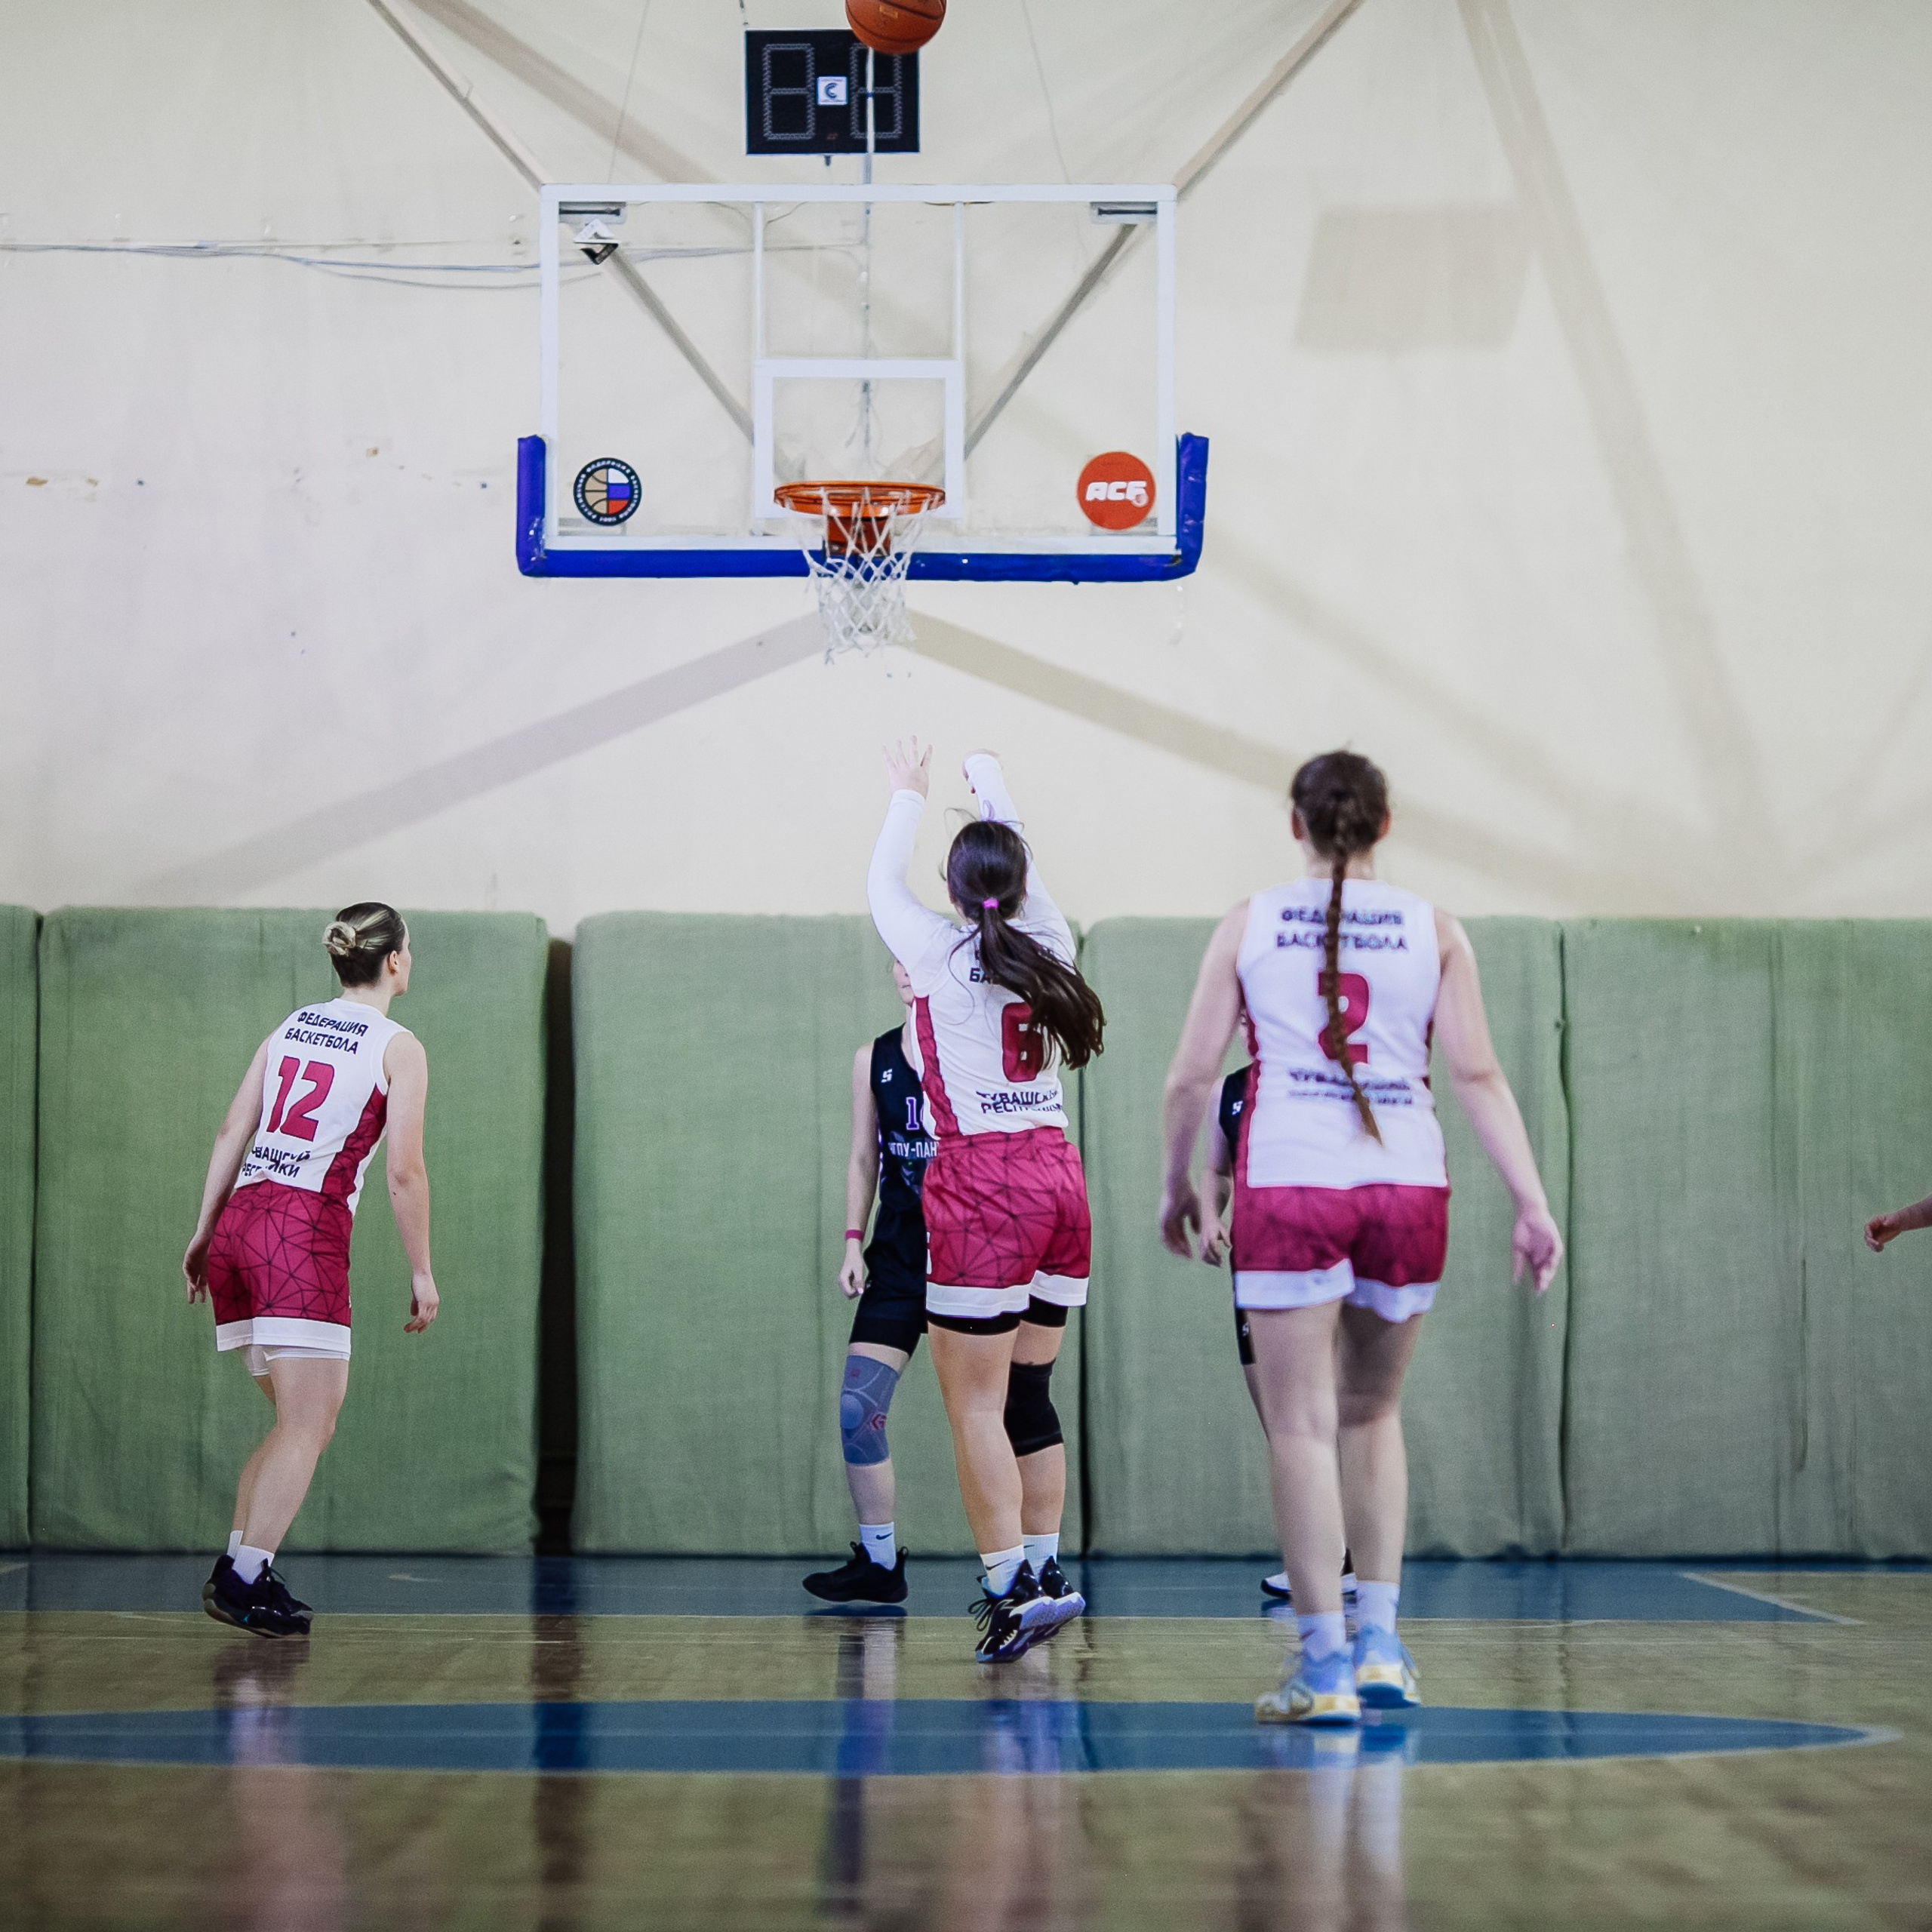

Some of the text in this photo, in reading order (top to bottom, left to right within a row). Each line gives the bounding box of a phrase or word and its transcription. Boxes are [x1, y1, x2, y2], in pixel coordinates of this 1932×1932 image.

[285, 1027, 359, 1054] БАСКЕТБОЛА
[297, 1011, 369, 1038] ФЕДЕРАЦИЯ
[1001, 1001, 1044, 1083] 6
[1318, 971, 1369, 1065] 2
[266, 1055, 334, 1143] 12
